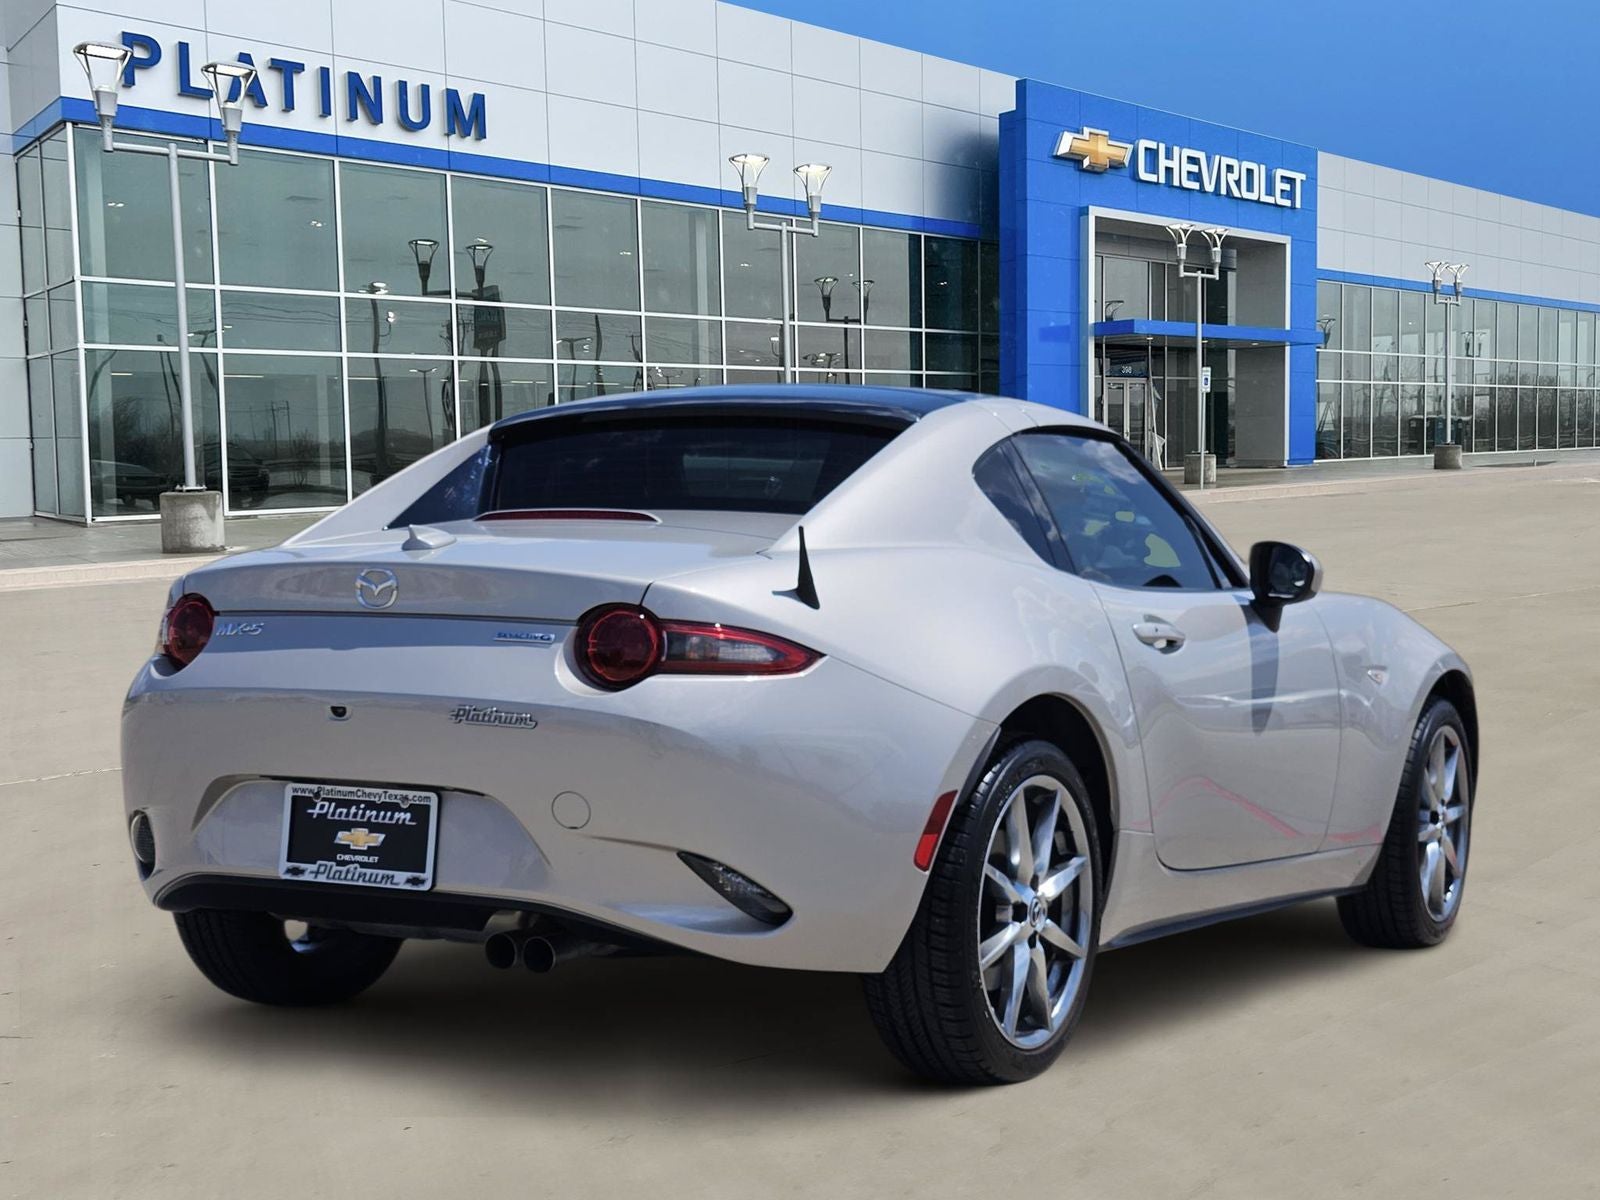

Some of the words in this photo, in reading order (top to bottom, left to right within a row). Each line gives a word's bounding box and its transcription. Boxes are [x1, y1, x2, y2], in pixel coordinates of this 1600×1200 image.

[121, 31, 487, 140] PLATINUM
[1136, 139, 1307, 209] CHEVROLET
[449, 704, 538, 729] Platinum
[306, 801, 417, 825] Platinum
[336, 853, 380, 863] CHEVROLET
[309, 863, 400, 886] Platinum
